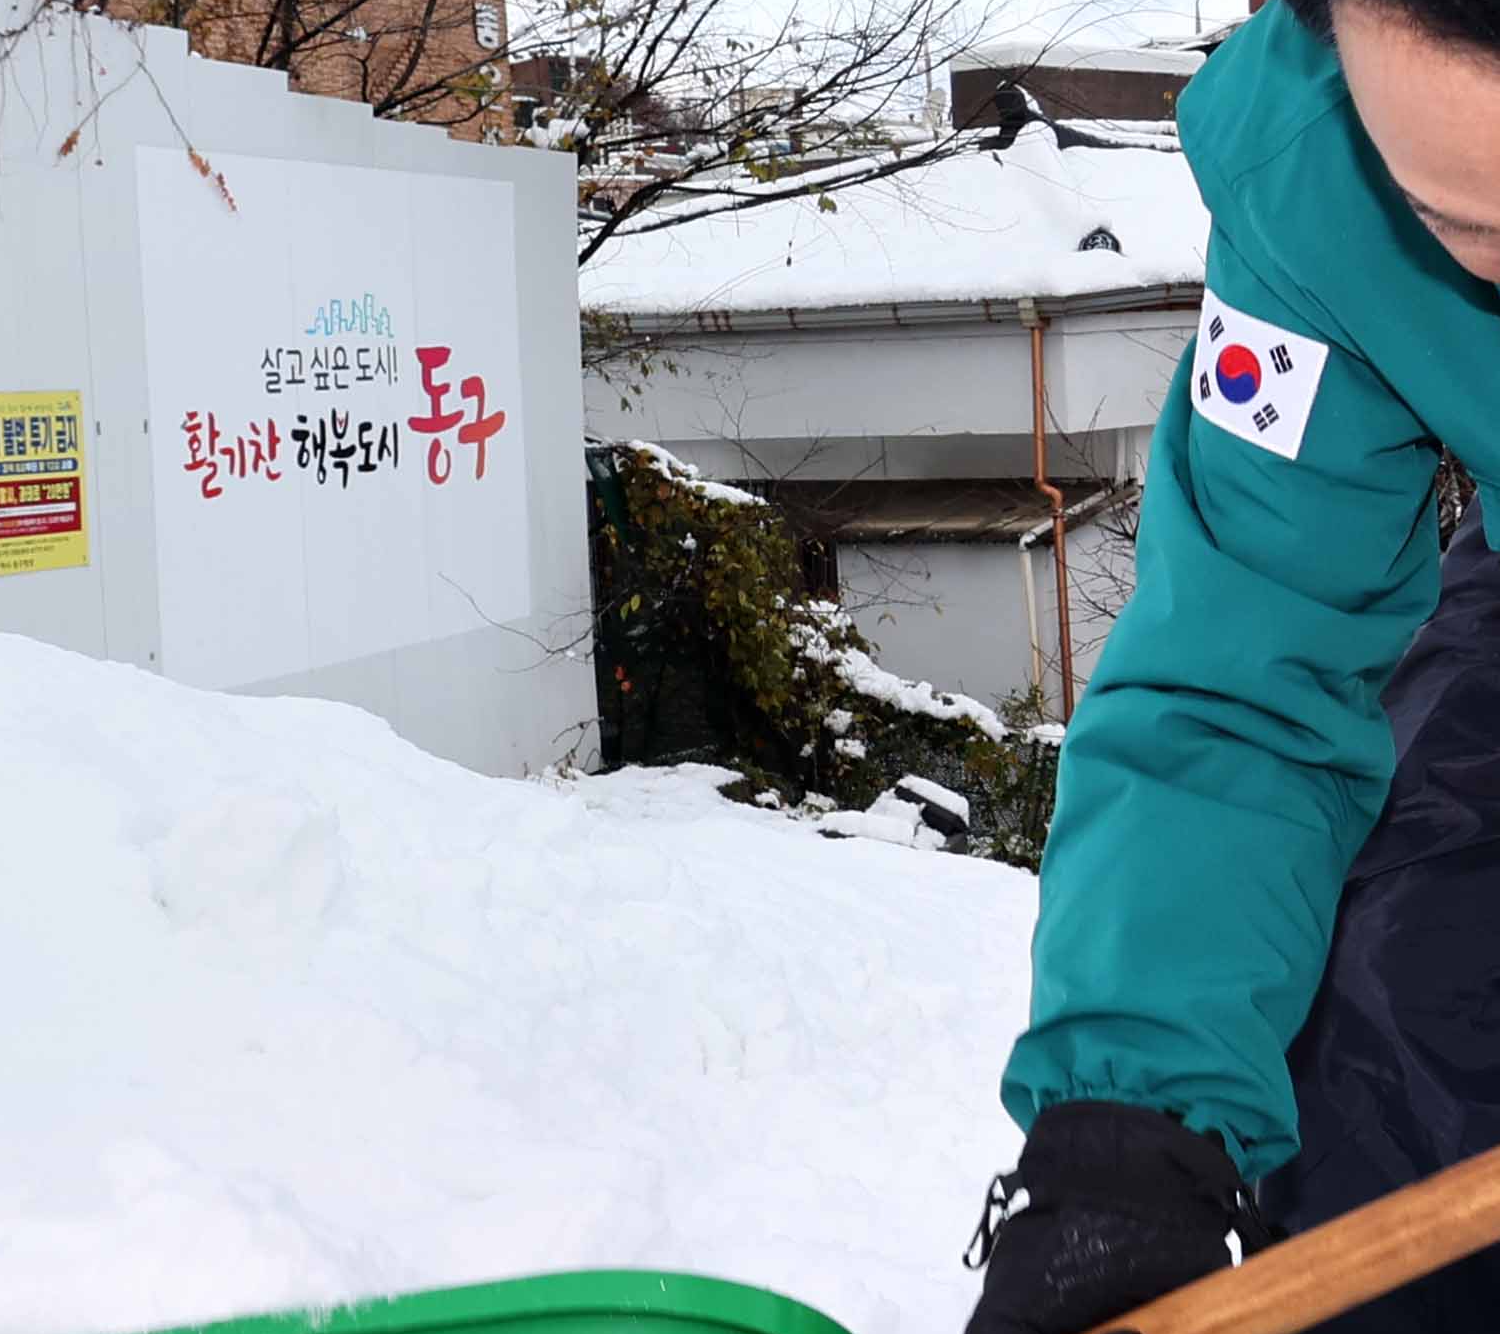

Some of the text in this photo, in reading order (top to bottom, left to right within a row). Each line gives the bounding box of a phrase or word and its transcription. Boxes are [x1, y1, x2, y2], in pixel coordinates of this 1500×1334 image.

[261, 343, 398, 394] 살고 싶은 도시!
[2, 417, 28, 456] 불법
[30, 416, 53, 454] 투기
[55, 415, 78, 453] 금지
[407, 345, 506, 485] 동구
[182, 407, 399, 499] 활기찬 행복도시
